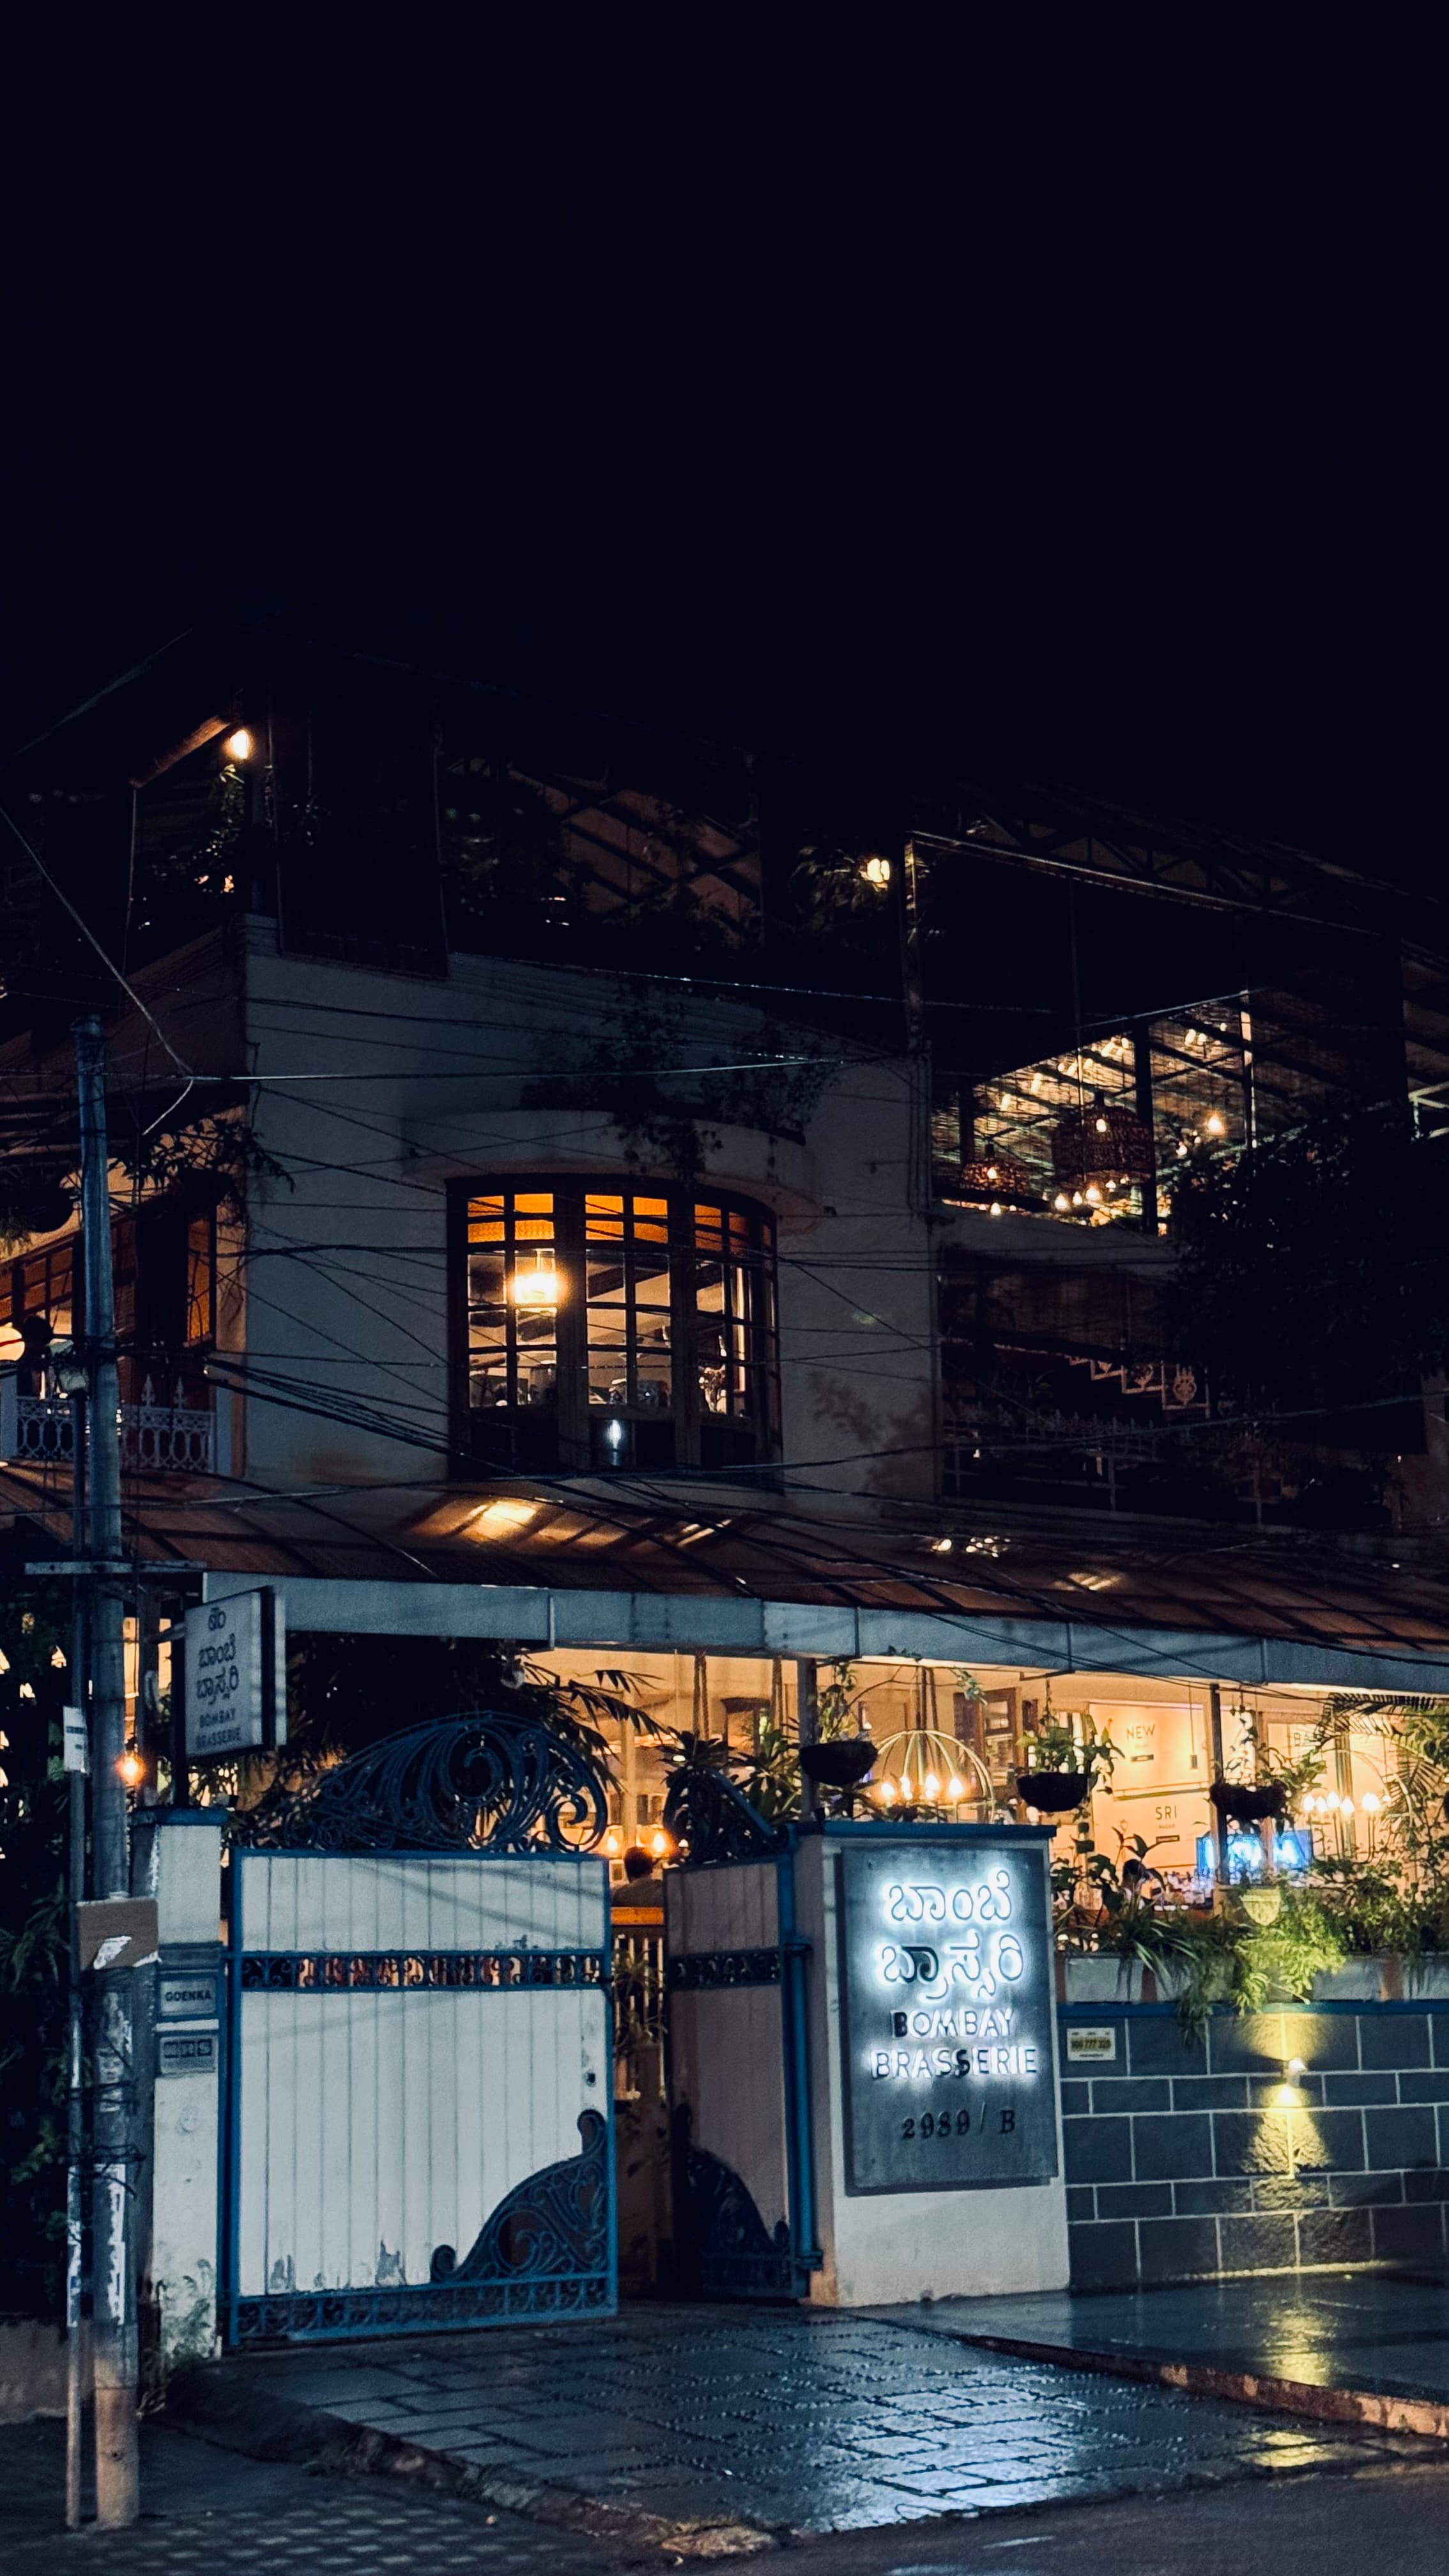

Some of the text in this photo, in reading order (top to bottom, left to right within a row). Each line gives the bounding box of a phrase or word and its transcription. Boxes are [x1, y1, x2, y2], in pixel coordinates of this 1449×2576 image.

[1126, 1724, 1155, 1740] NEW
[1155, 1805, 1177, 1820] SRI
[889, 1869, 1012, 1922] ಬಾಂಬೆ
[164, 1989, 211, 2002] GOENKA
[892, 2008, 1015, 2038] BOMBAY
[871, 2046, 1037, 2080] BRASSERIE
